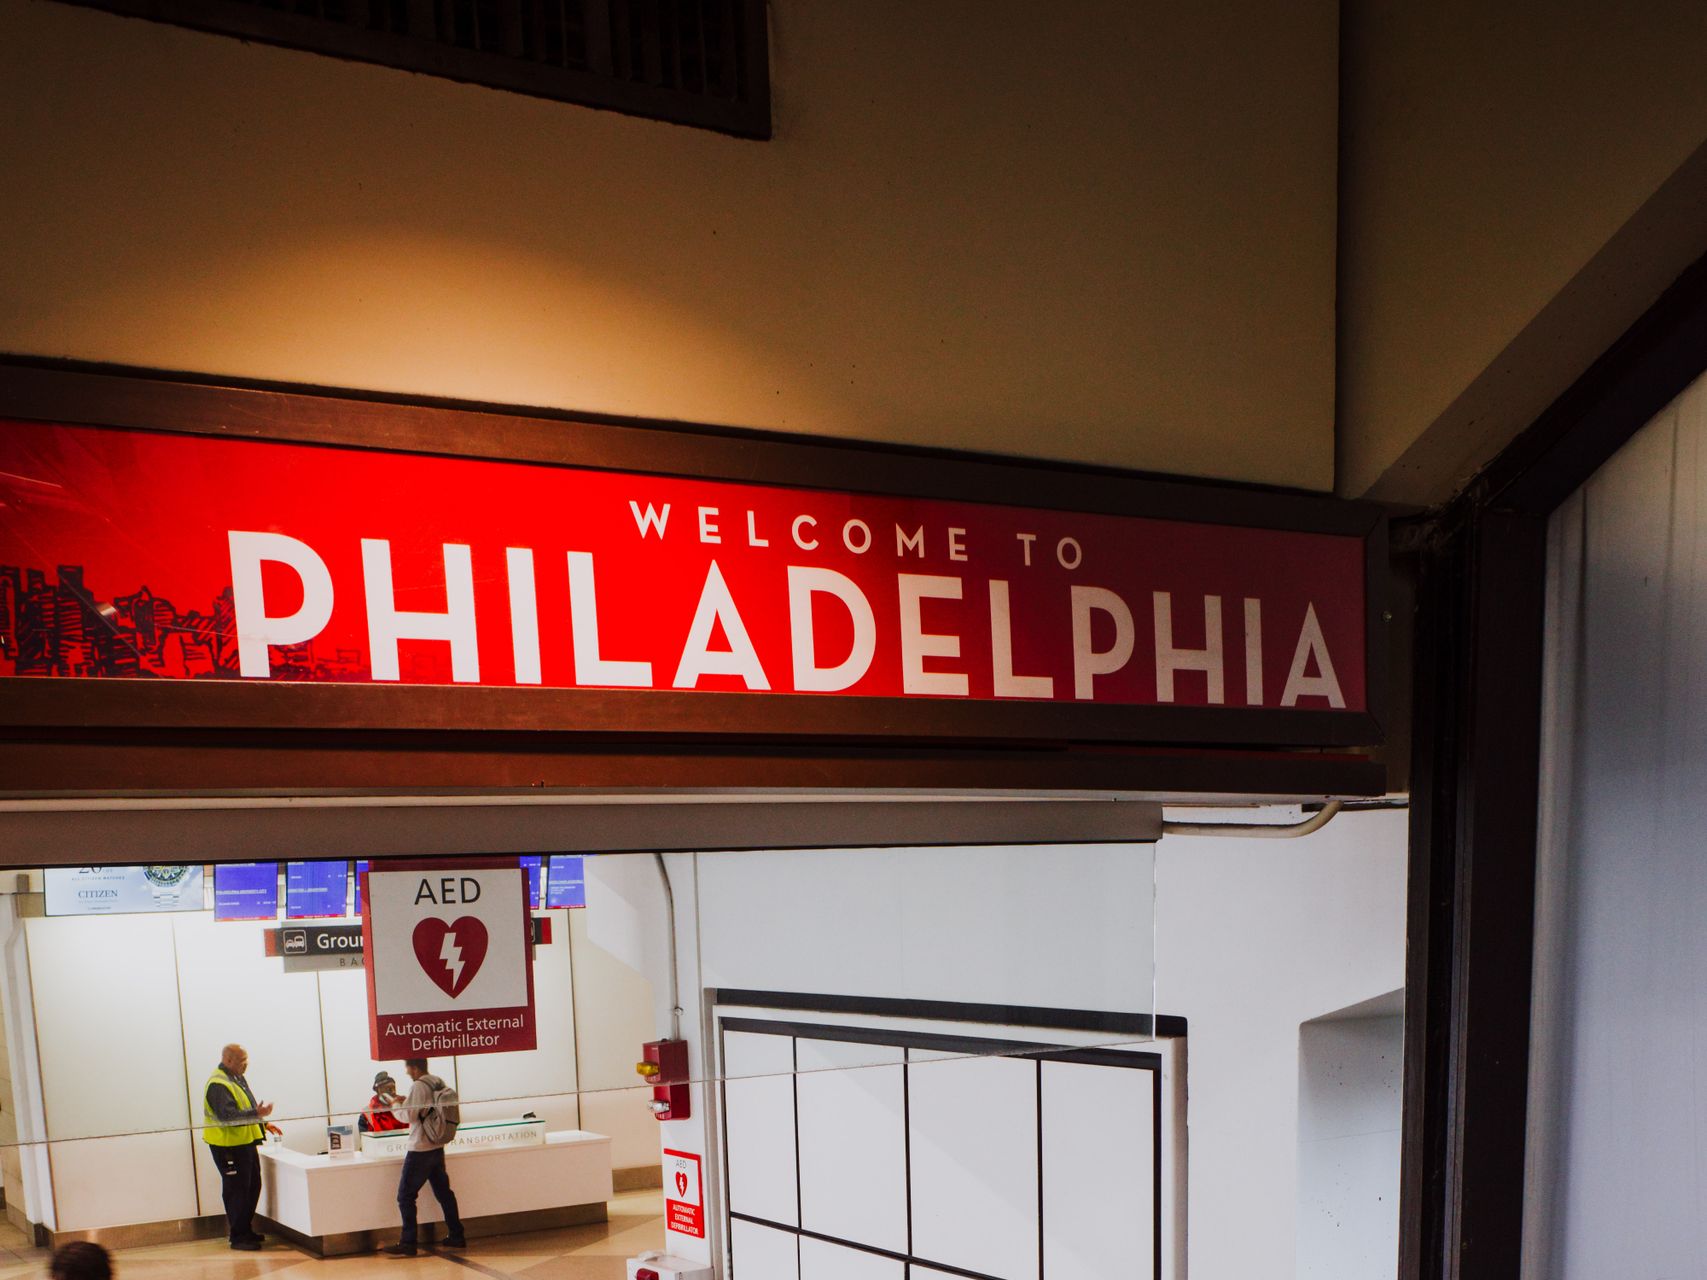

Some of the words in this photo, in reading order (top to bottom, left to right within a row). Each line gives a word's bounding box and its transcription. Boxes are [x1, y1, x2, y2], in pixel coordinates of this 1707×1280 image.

[629, 500, 969, 562] WELCOME
[1017, 532, 1083, 570] TO
[228, 530, 1347, 709] PHILADELPHIA
[78, 889, 118, 899] CITIZEN
[414, 877, 481, 905] AED
[385, 1018, 462, 1037] Automatic
[466, 1014, 524, 1031] External
[411, 1033, 500, 1051] Defibrillator
[450, 1130, 537, 1146] RANSPORTATION
[675, 1159, 687, 1169] AED
[672, 1203, 696, 1216] AUTOMATIC
[674, 1213, 694, 1224] EXTERNAL
[670, 1221, 699, 1234] DEFIBRILLATOR
